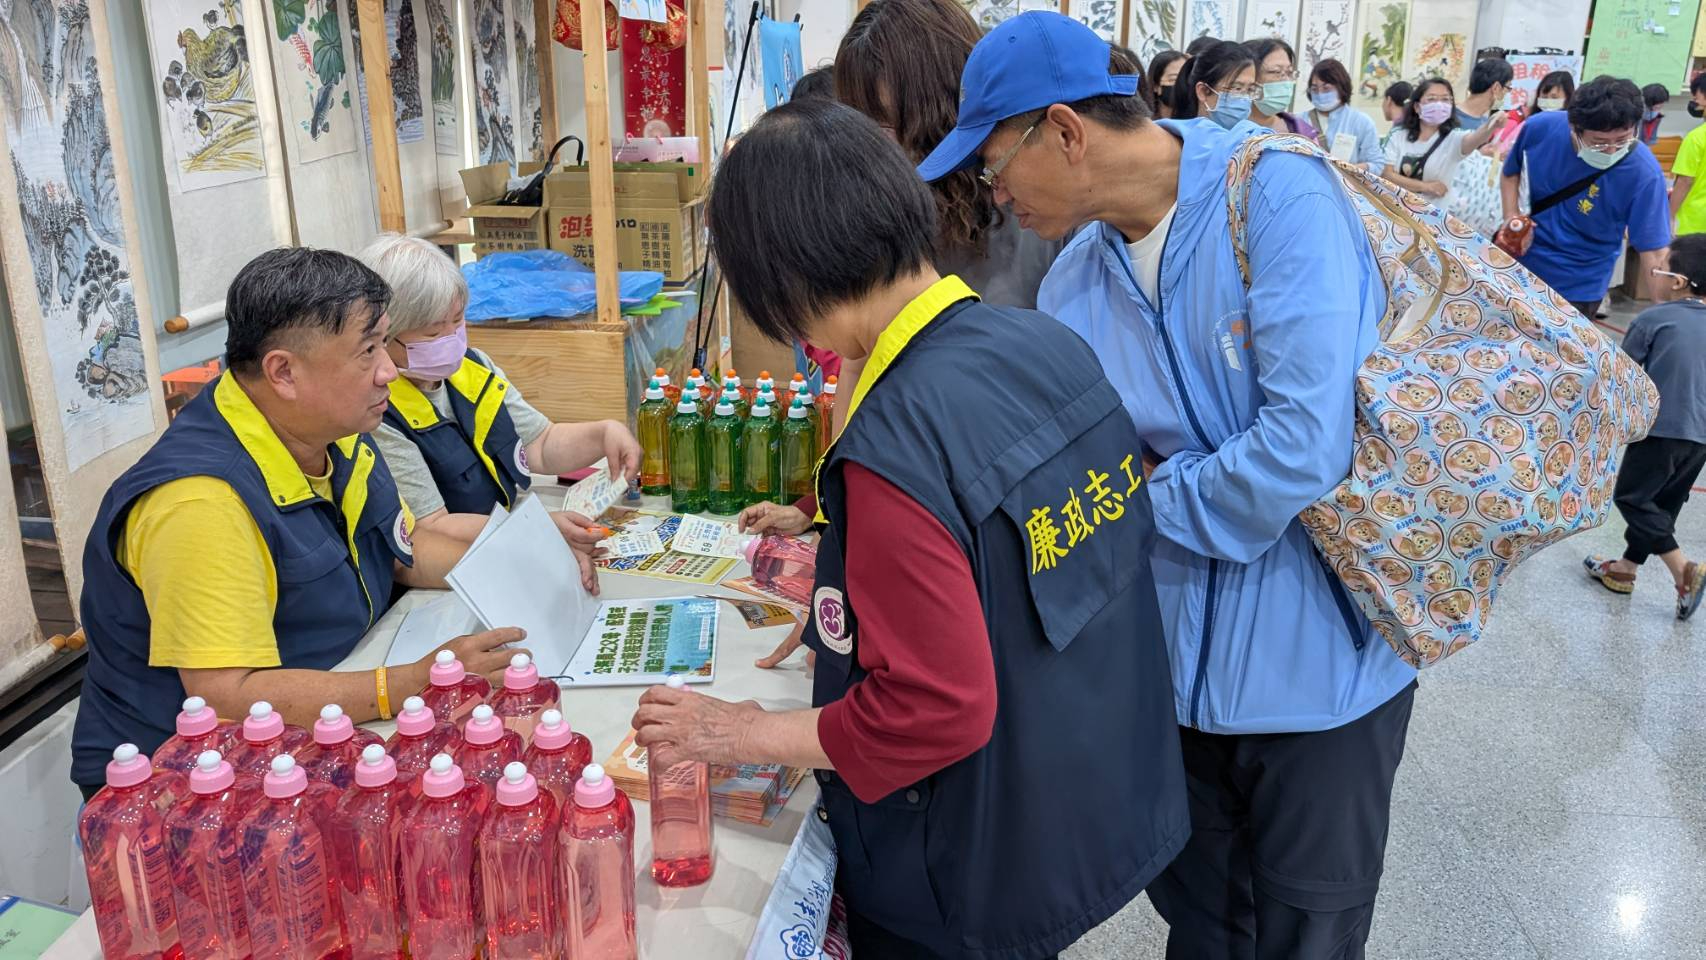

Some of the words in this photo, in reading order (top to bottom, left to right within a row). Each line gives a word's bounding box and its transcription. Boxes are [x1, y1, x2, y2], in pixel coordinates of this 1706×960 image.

[1387, 369, 1413, 384] Duffy
[1495, 365, 1518, 383] Duffy
[1471, 402, 1491, 416] Duffy
[1367, 472, 1393, 488] Duffy
[1469, 473, 1497, 488] Duffy
[1394, 486, 1416, 499] Duffy
[1501, 487, 1524, 502] Duffy
[1026, 455, 1142, 574] 廉政志工
[1396, 515, 1422, 531] Duffy
[1501, 519, 1529, 533] Duffy
[1463, 547, 1484, 561] Duffy
[1446, 621, 1472, 634] Duffy
